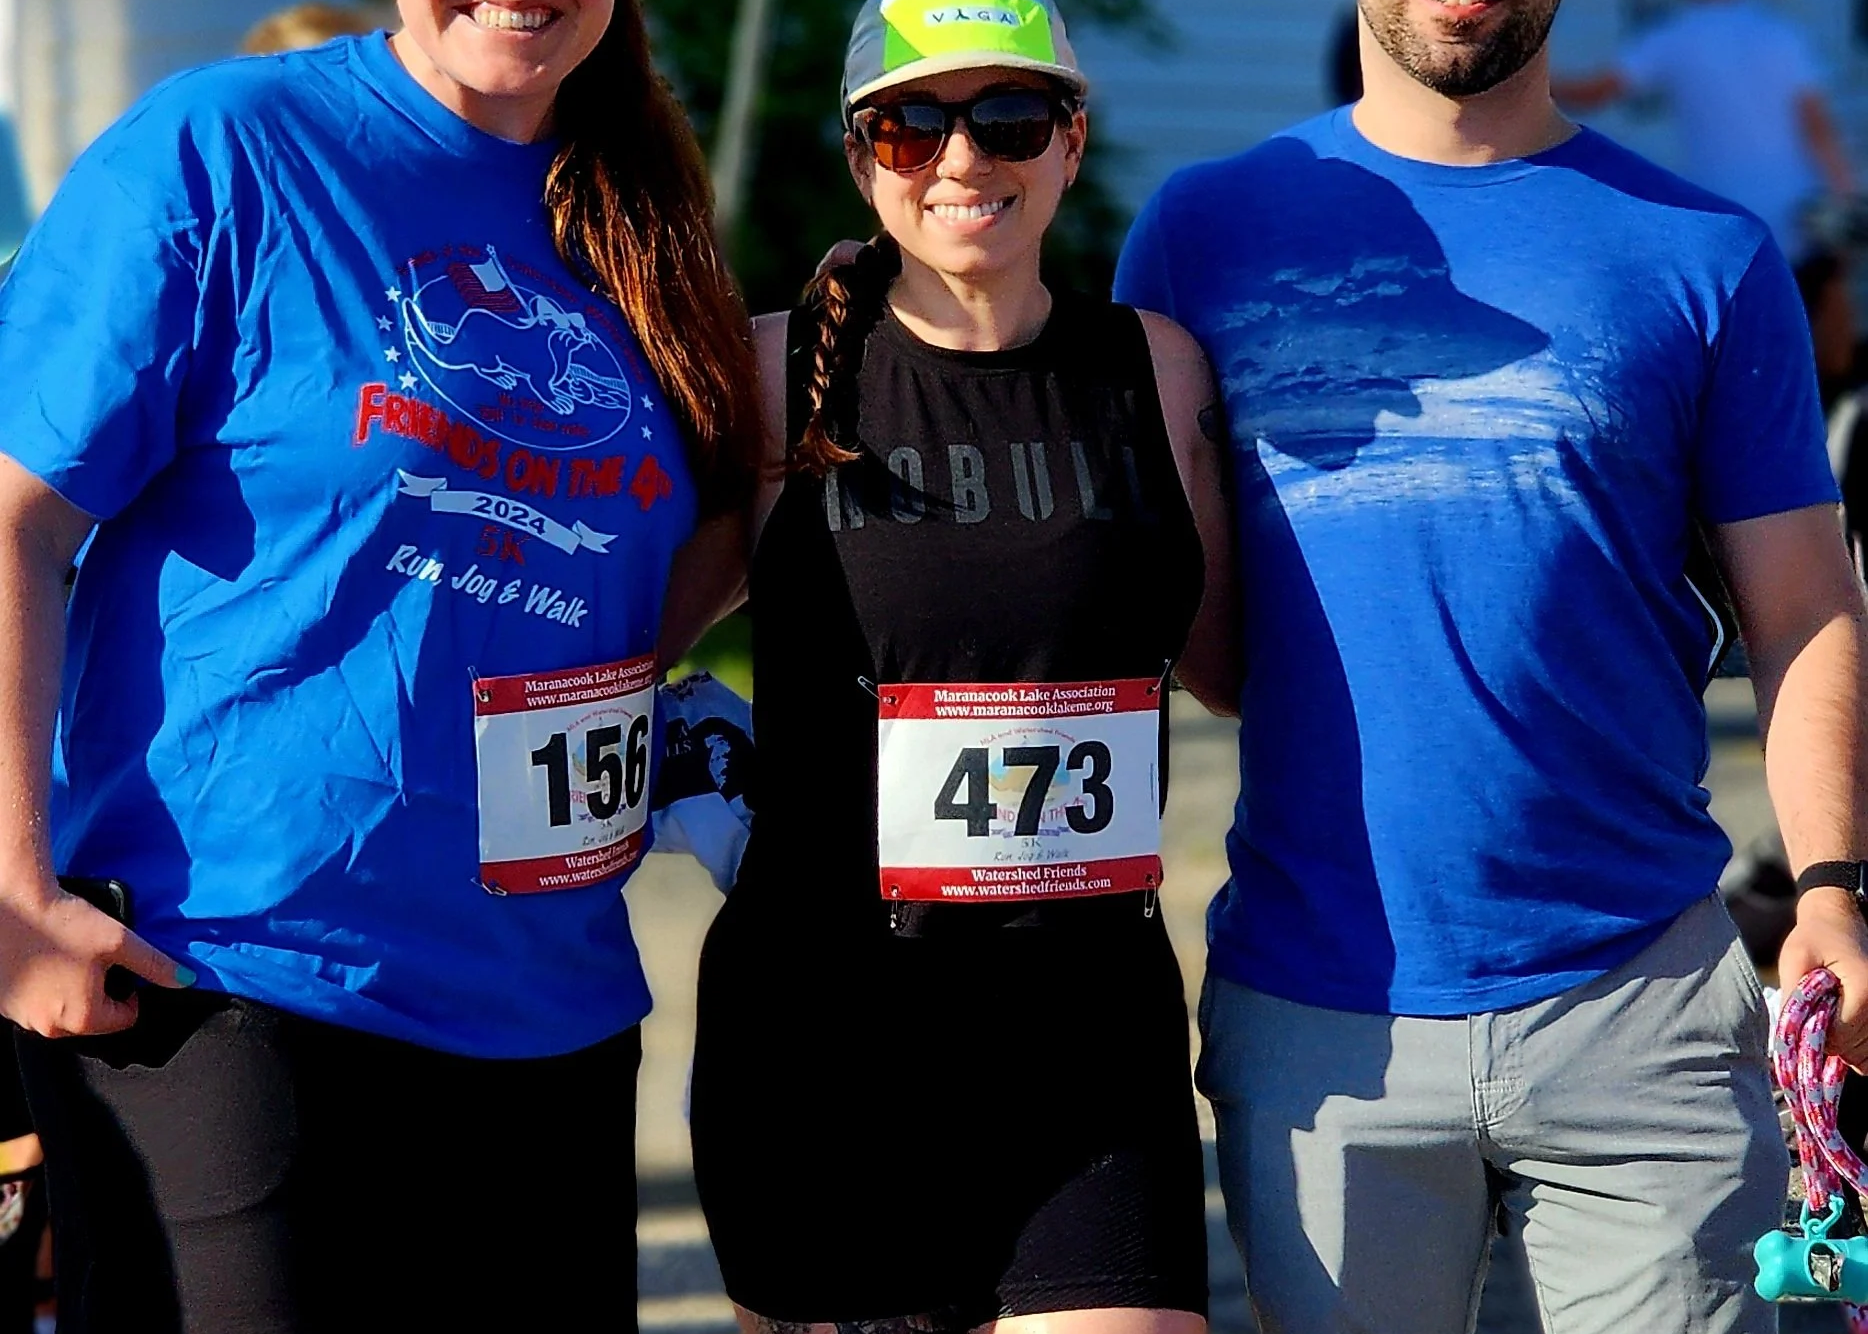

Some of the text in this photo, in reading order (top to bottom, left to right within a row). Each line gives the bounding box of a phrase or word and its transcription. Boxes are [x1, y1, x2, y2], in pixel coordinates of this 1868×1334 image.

[352, 382, 501, 480] FRIENDS
[505, 448, 561, 498] ON
[568, 455, 626, 499] THE
[472, 495, 547, 535] 2024
[477, 525, 530, 566] 5K
[386, 544, 588, 628] Run, Jog & Walk
[525, 673, 594, 693] Maranacook
[595, 669, 616, 683] Lake
[934, 685, 1116, 703] Maranacook Lake Association
[935, 699, 1114, 716] www.maranacooklakeme.org
[531, 714, 649, 827] 156
[934, 740, 1114, 837] 473
[941, 877, 1111, 896] www.watershedfriends.com
[971, 864, 1087, 882] Watershed Friends
